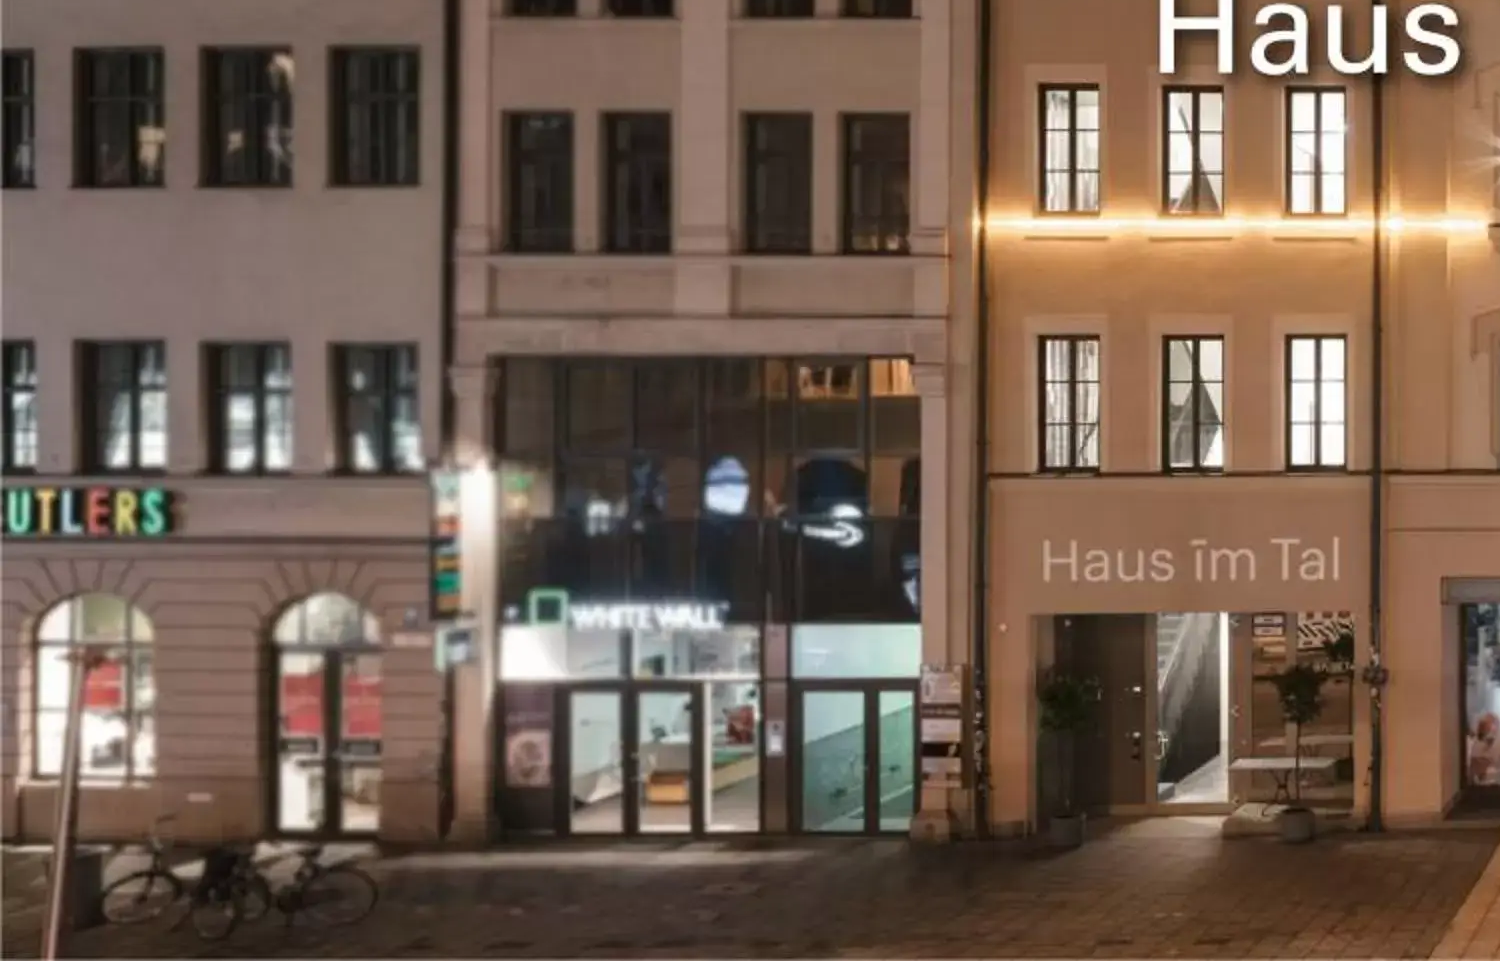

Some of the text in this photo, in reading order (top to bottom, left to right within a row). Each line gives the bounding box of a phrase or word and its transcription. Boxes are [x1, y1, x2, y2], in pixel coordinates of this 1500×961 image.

[7, 487, 166, 535] UTLERS
[1042, 539, 1176, 582] Haus
[1270, 536, 1340, 581] Tal
